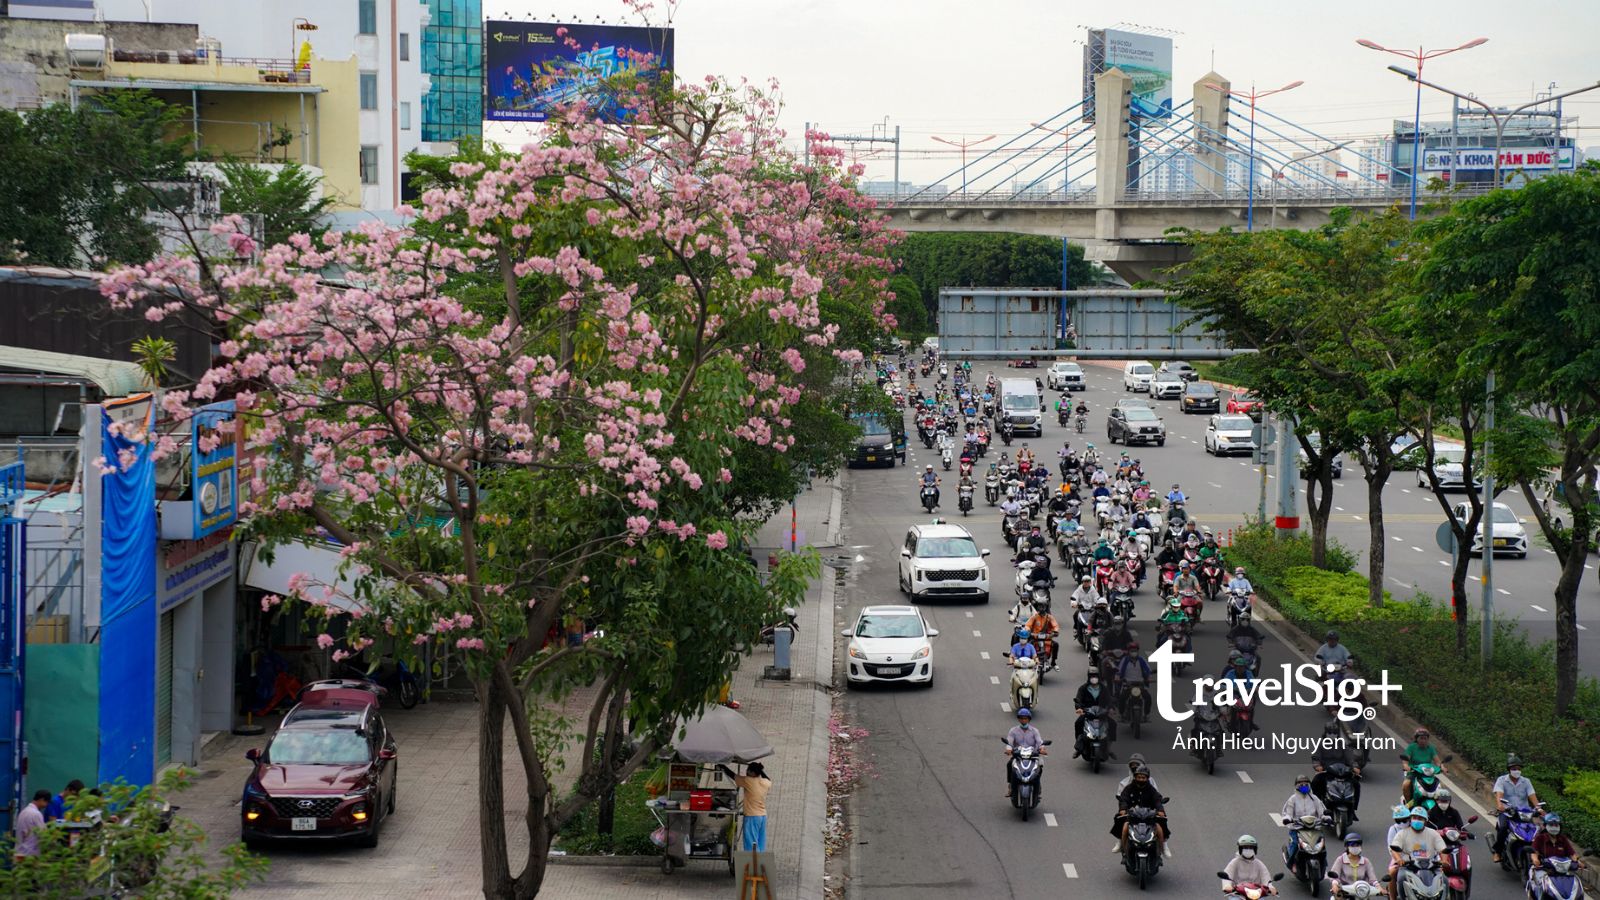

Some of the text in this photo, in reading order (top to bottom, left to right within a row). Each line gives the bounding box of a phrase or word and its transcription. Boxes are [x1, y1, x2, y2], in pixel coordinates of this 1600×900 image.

[1464, 154, 1494, 166] KHOA
[1498, 151, 1523, 165] TÂM
[1527, 151, 1551, 165] ĐỨC
